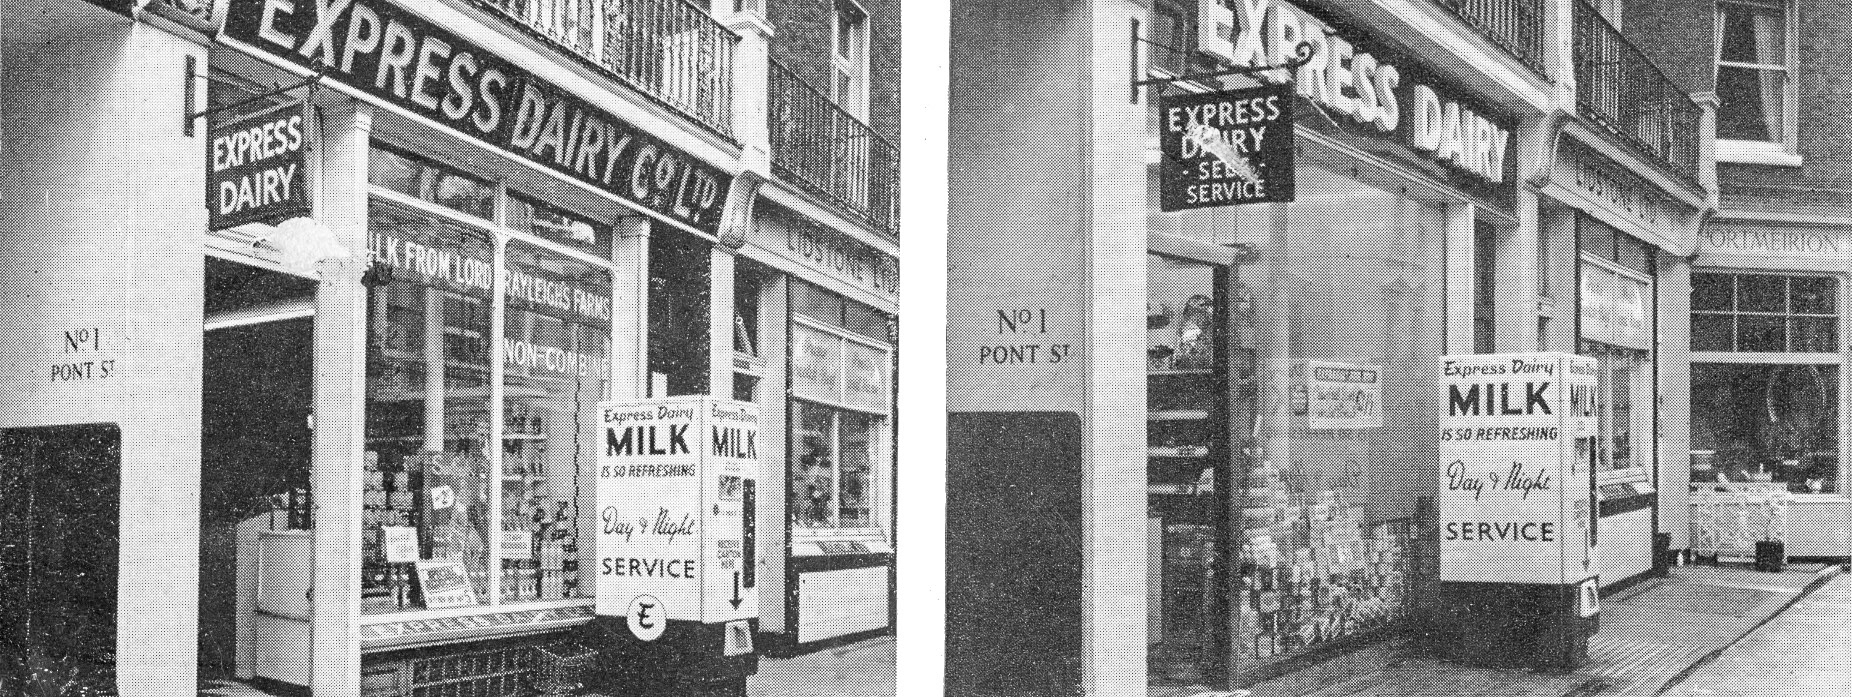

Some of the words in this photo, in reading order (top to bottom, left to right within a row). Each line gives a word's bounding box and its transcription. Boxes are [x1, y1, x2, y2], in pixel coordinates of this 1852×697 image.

[259, 0, 506, 133] EXPRESS
[511, 83, 632, 184] DAIRY
[1199, 0, 1399, 132] EXPRESS
[1413, 84, 1508, 183] DAIRY
[1169, 95, 1280, 132] EXPRESS
[213, 115, 301, 173] EXPRESS
[1199, 157, 1250, 180] SEL
[220, 163, 296, 215] DAIRY
[1186, 179, 1265, 204] SERVICE
[405, 241, 450, 280] FROM
[456, 255, 492, 290] LORD
[786, 219, 863, 282] LIDSTONE
[51, 361, 94, 381] PONT
[979, 344, 1040, 365] PONT
[1444, 360, 1506, 378] Express
[1511, 358, 1554, 376] Dairy
[604, 408, 653, 425] Express
[657, 405, 693, 421] Dairy
[1449, 381, 1552, 416] MILK
[1569, 383, 1597, 417] MILK
[606, 424, 690, 456] MILK
[712, 424, 757, 460] MILK
[1441, 428, 1454, 441] IS
[1456, 428, 1472, 440] SO
[1476, 426, 1558, 441] REFRESHING
[601, 466, 611, 478] IS
[613, 465, 626, 477] SO
[628, 463, 696, 477] REFRESHING
[1447, 460, 1484, 501] Day
[1503, 461, 1550, 501] Night
[602, 505, 634, 542] Day
[652, 506, 695, 545] Night
[1446, 521, 1554, 542] SERVICE
[602, 558, 695, 578] SERVICE
